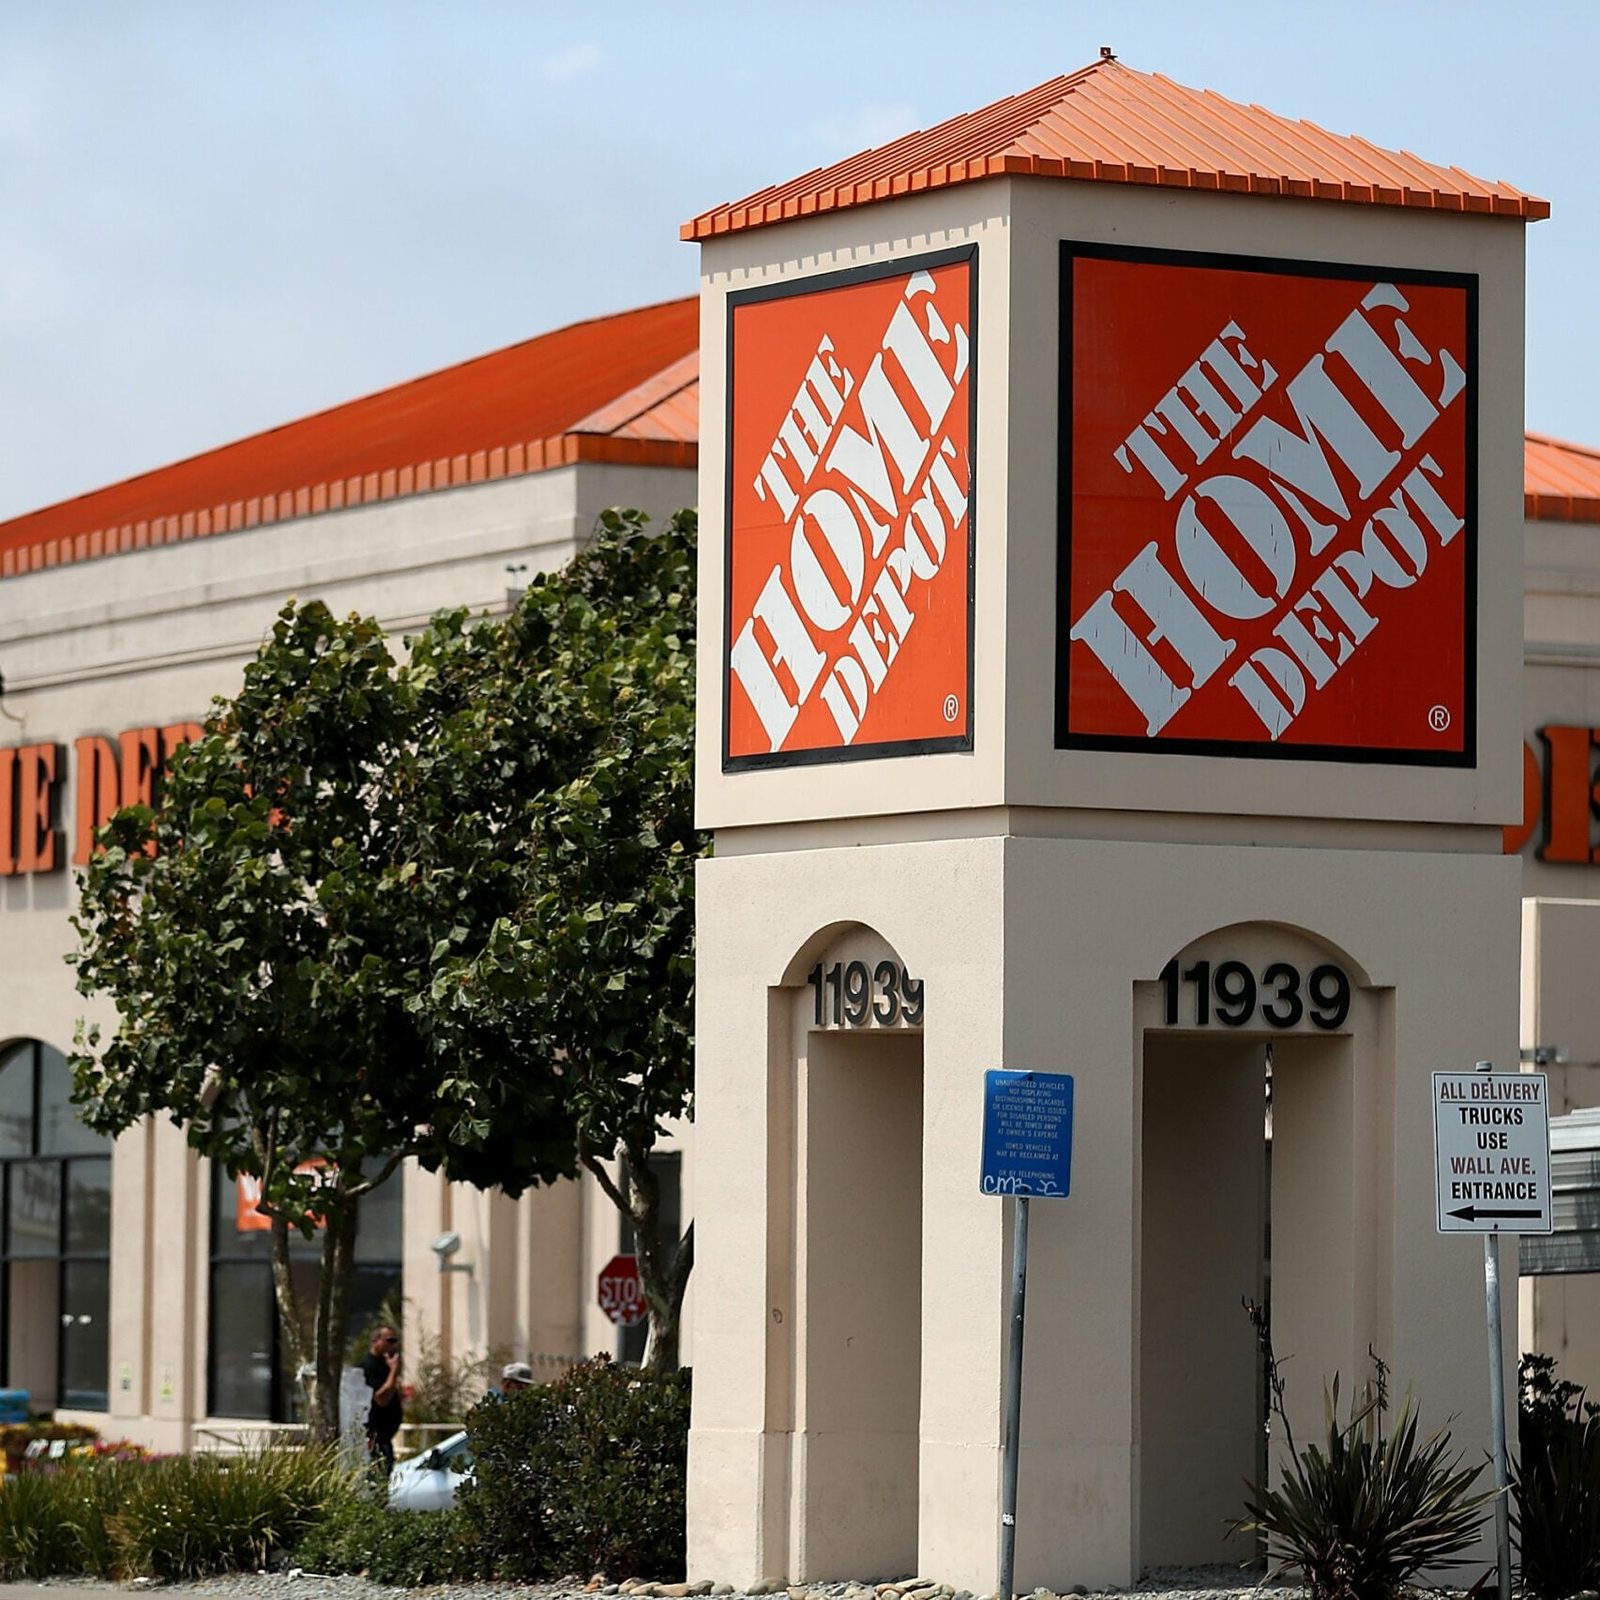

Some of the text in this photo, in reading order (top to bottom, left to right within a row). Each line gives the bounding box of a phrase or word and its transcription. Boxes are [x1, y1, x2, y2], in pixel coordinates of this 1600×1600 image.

[1113, 320, 1279, 501] THE
[753, 333, 855, 524] THE
[731, 269, 969, 752] HOME
[1070, 282, 1466, 738] HOME
[820, 436, 969, 746] DEPOT
[1228, 453, 1465, 740] DEPOT
[808, 961, 924, 1025] 11939
[1159, 960, 1351, 1030] 11939
[1039, 1082, 1065, 1090] VEHICLES
[1440, 1082, 1540, 1100] ALL DELIVERY
[1002, 1104, 1024, 1112] LICENSE
[1047, 1107, 1067, 1115] ISSUED
[1009, 1113, 1035, 1121] DISABLED
[1037, 1115, 1062, 1123] PERSONS
[1459, 1107, 1523, 1125] TRUCKS
[1005, 1142, 1051, 1152] TOWED VEHICLES
[1477, 1132, 1508, 1149] USE
[1019, 1152, 1050, 1160] RECLAIMED
[1018, 1171, 1055, 1179] TELEPHONING
[1451, 1157, 1536, 1175] WALL AVE.
[1452, 1182, 1537, 1199] ENTRANCE
[600, 1277, 641, 1301] STO
